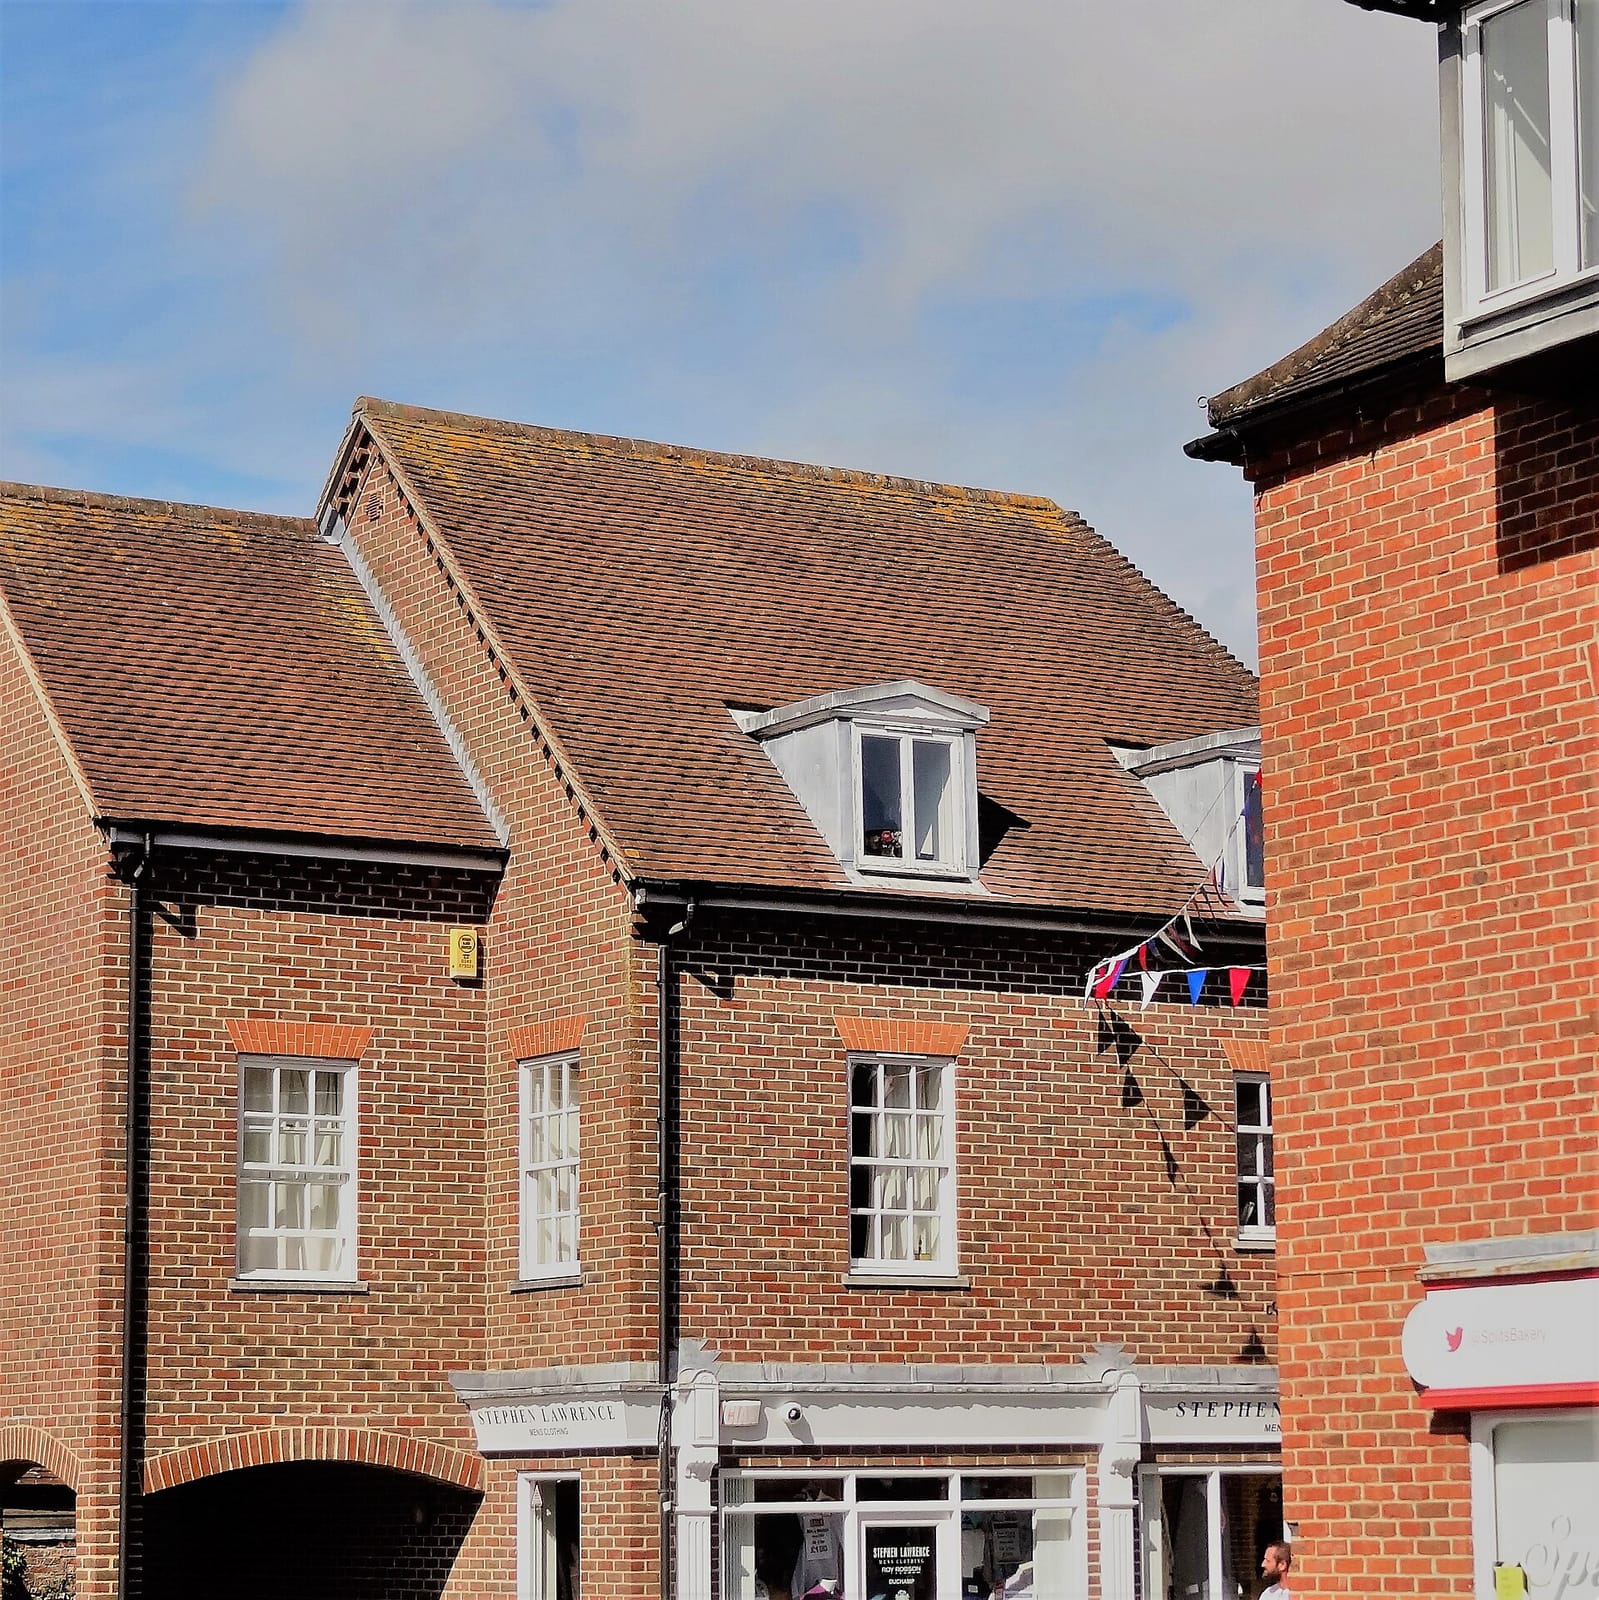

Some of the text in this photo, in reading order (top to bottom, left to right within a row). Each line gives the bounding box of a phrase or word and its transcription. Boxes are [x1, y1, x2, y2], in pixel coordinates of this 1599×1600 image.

[477, 1404, 616, 1425] STEPHEN LAWRENCE
[1175, 1401, 1281, 1418] STEPHEN
[544, 1427, 569, 1436] CLOTHING
[873, 1546, 930, 1558] STEPHEN LAWRENCE
